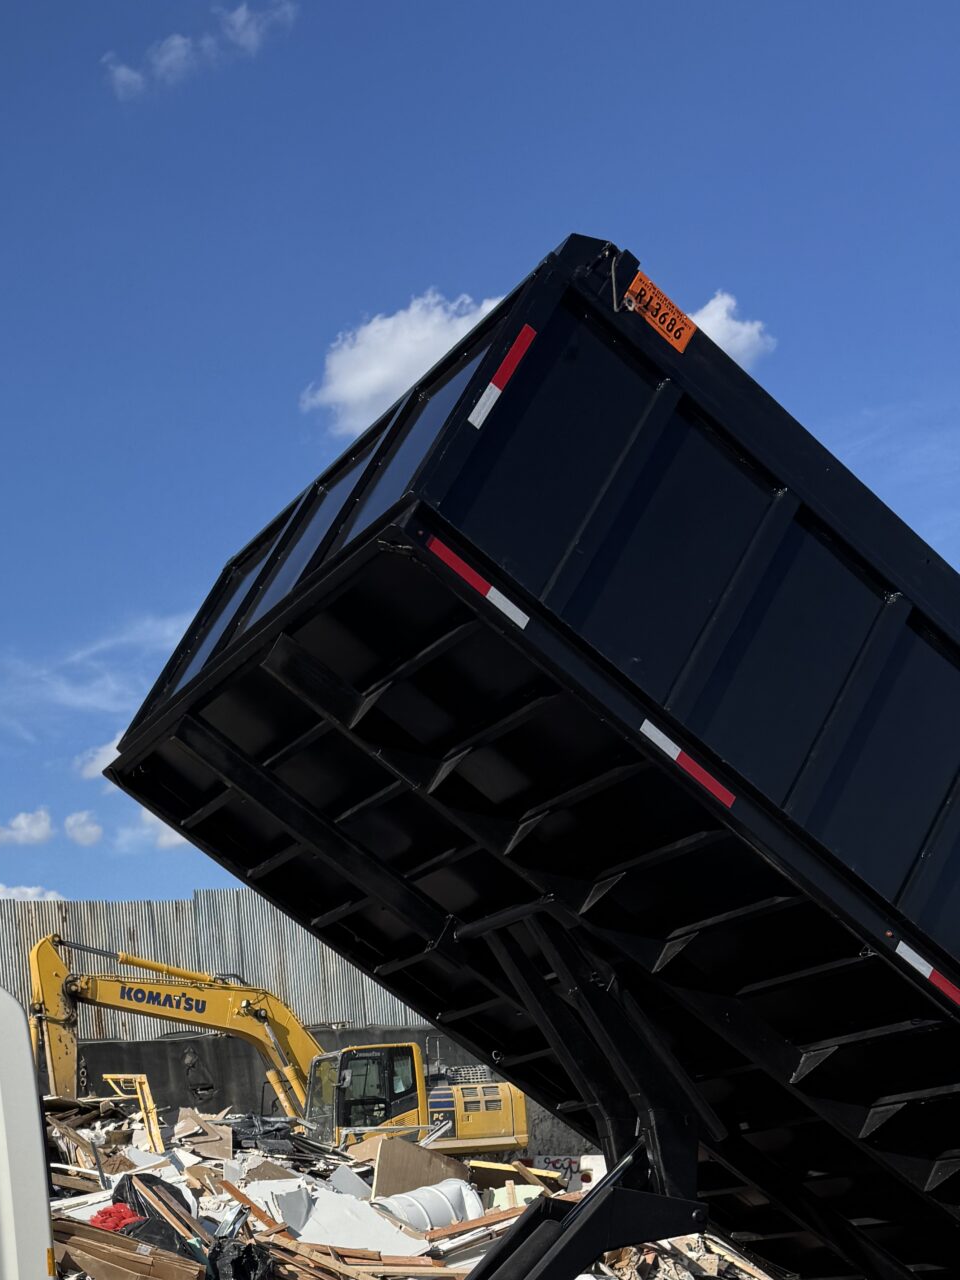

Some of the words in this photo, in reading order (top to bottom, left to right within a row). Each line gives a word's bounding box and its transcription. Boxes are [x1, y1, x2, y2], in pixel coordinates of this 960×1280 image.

[635, 287, 685, 341] R13686
[120, 986, 206, 1014] KOMATSU
[432, 1112, 444, 1121] PC
